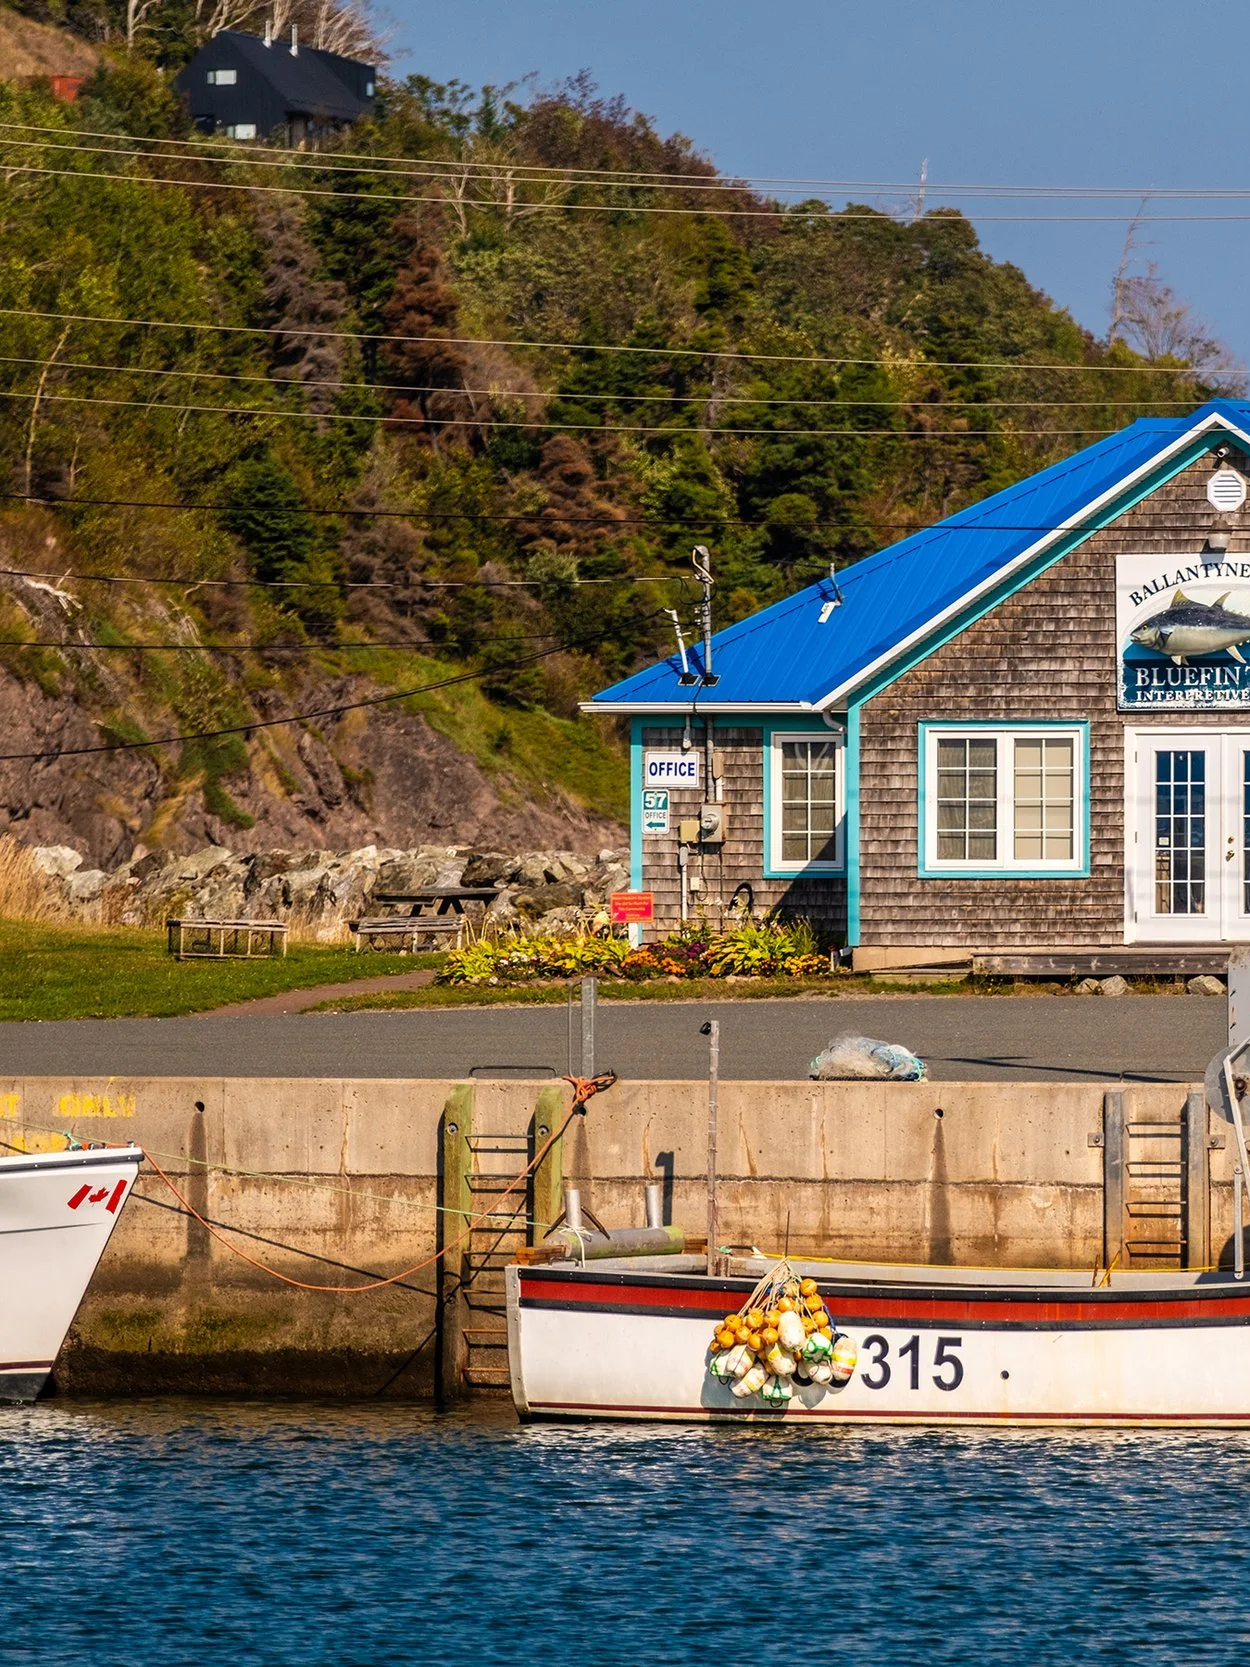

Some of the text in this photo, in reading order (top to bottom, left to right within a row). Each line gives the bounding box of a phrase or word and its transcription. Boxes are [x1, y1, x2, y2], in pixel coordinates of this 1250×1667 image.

[1135, 666, 1240, 687] BLUEFIN
[1136, 690, 1250, 702] INTERPRETIVE
[649, 761, 696, 777] OFFICE
[644, 792, 667, 809] 57
[644, 811, 667, 820] OFFICE
[57, 1093, 137, 1118] ONLY
[793, 1333, 965, 1392] 315
